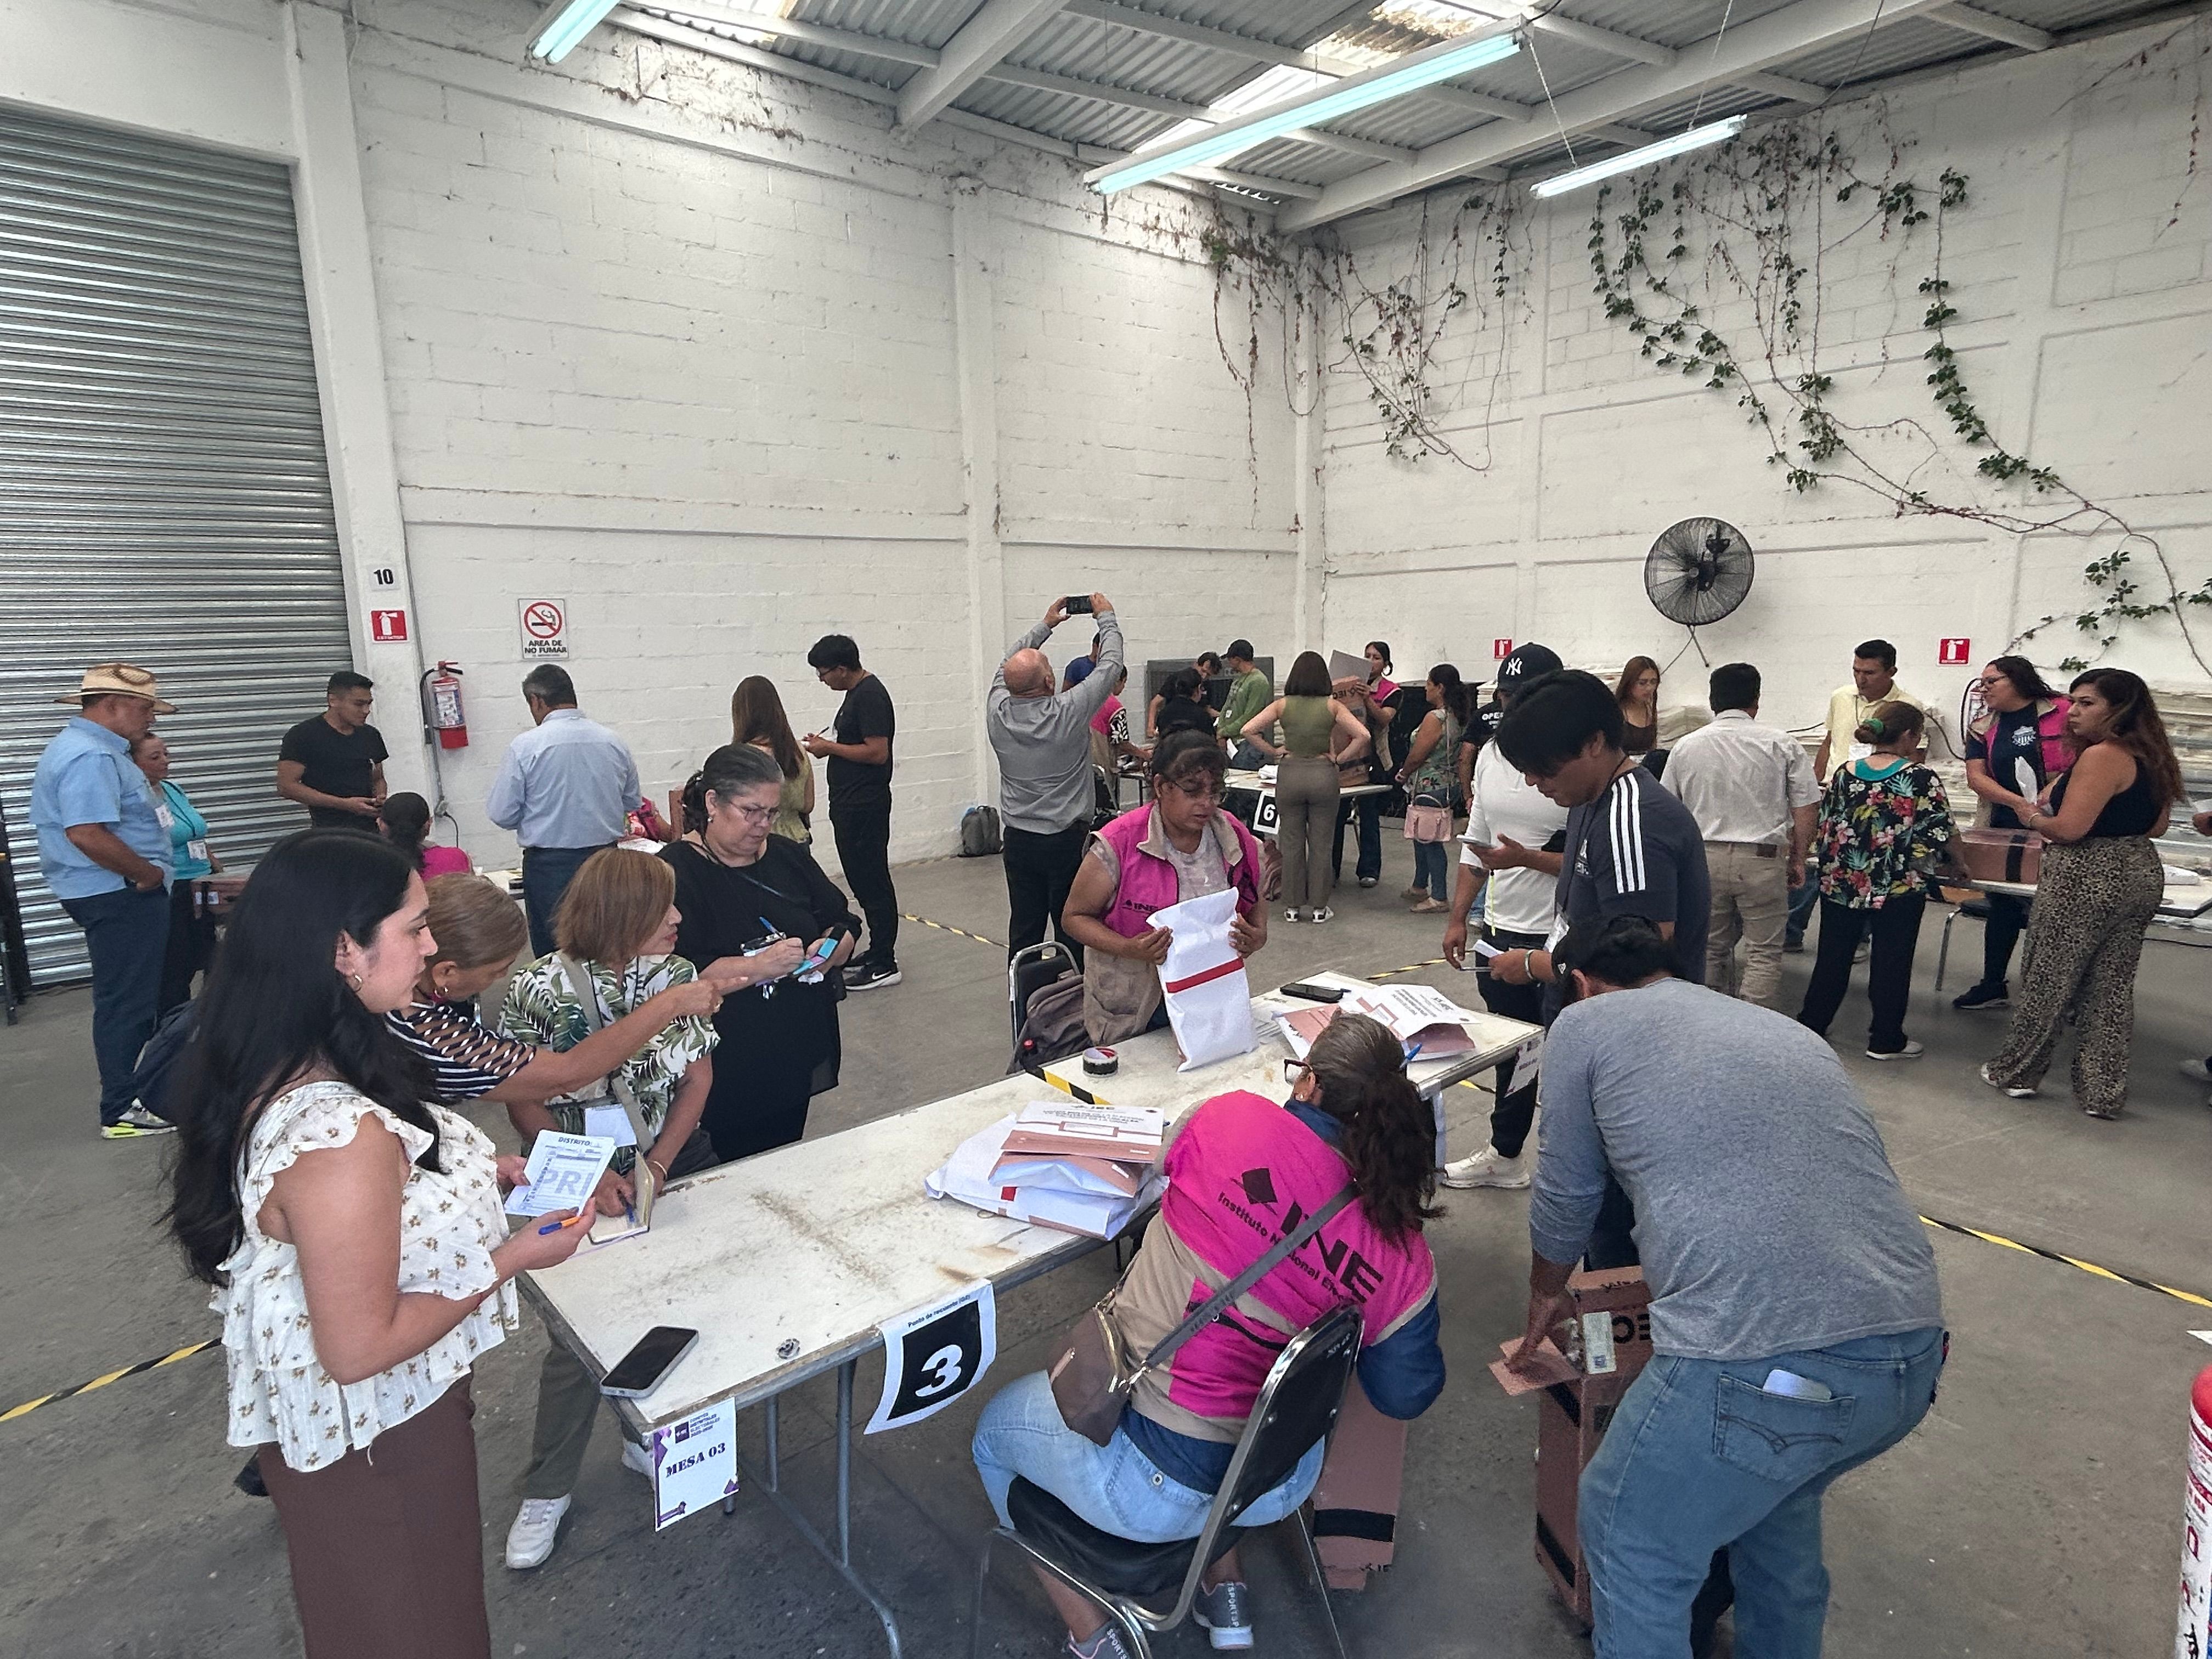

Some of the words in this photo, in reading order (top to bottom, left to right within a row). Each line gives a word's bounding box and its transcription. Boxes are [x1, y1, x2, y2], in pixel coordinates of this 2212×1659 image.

[373, 568, 394, 585] 10
[1263, 804, 1276, 821] 6
[1217, 1192, 1268, 1237] Instituto
[1269, 1232, 1320, 1280] Nional
[915, 1344, 963, 1397] 3
[665, 1452, 705, 1478] MESA
[708, 1442, 725, 1457] 03
